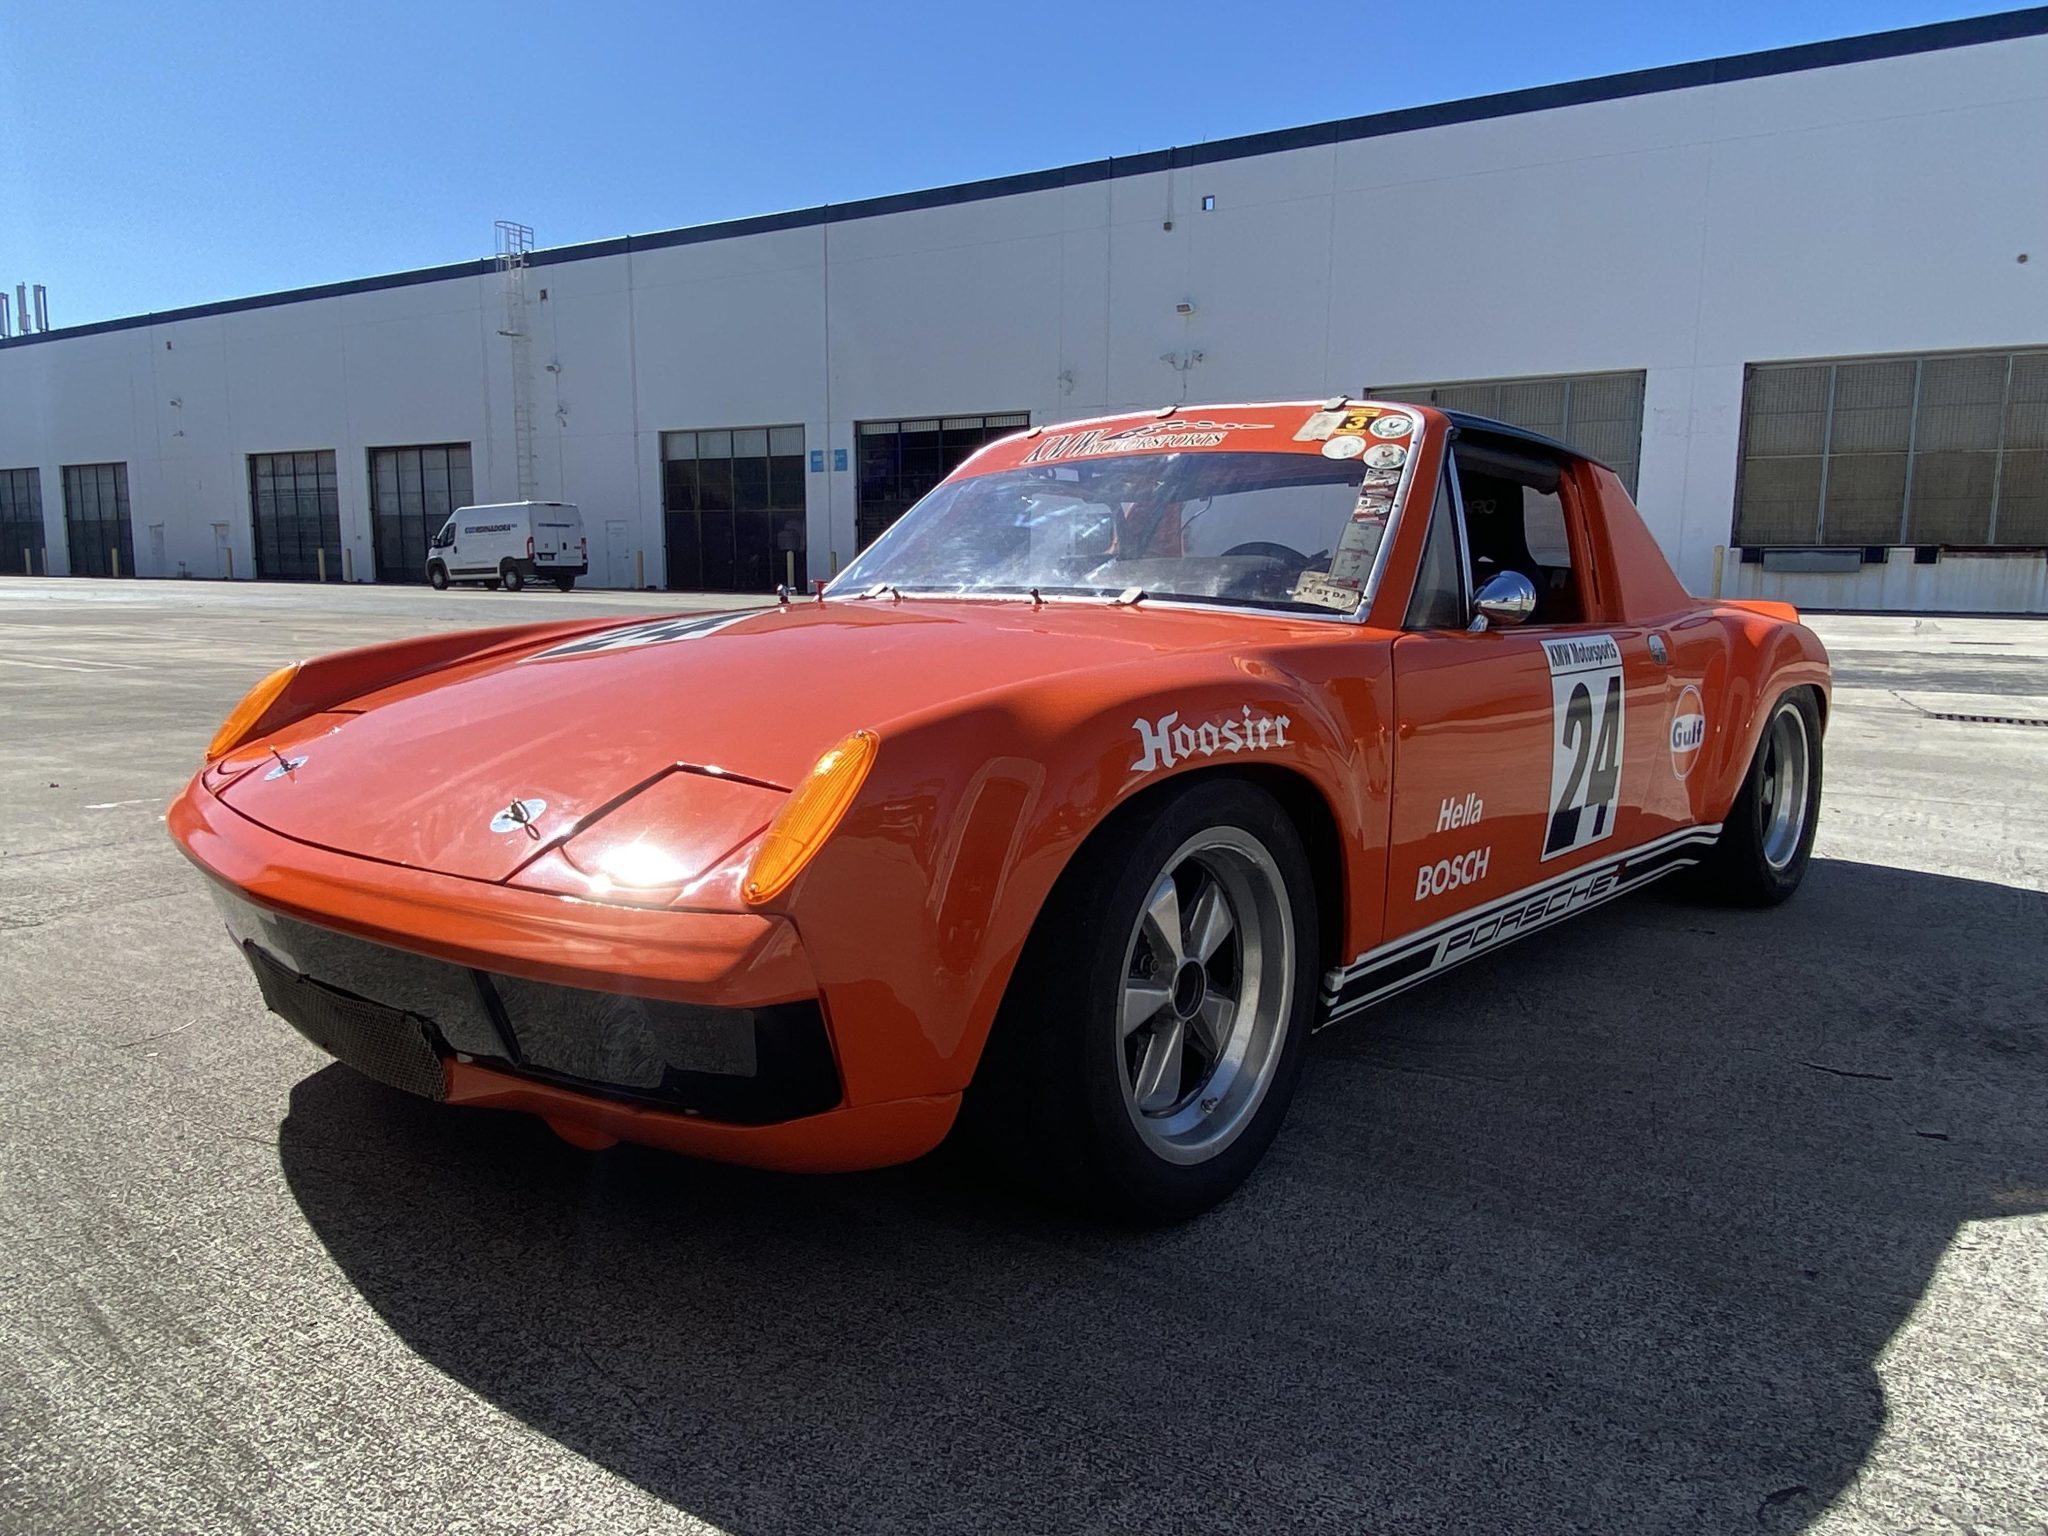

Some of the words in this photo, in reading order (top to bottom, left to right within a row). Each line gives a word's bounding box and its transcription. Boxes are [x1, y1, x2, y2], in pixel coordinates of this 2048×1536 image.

[1018, 427, 1112, 465] KMW
[1086, 431, 1228, 454] MOTORSPORTS
[1547, 643, 1572, 667] KMW
[1569, 639, 1617, 665] Motorsports
[1129, 704, 1291, 772] Hoosier
[1672, 719, 1703, 748] Gulf
[1544, 675, 1621, 855] 24
[1436, 793, 1483, 833] Hella
[1415, 846, 1491, 901] BOSCH
[1441, 874, 1619, 963] PORSCHE
